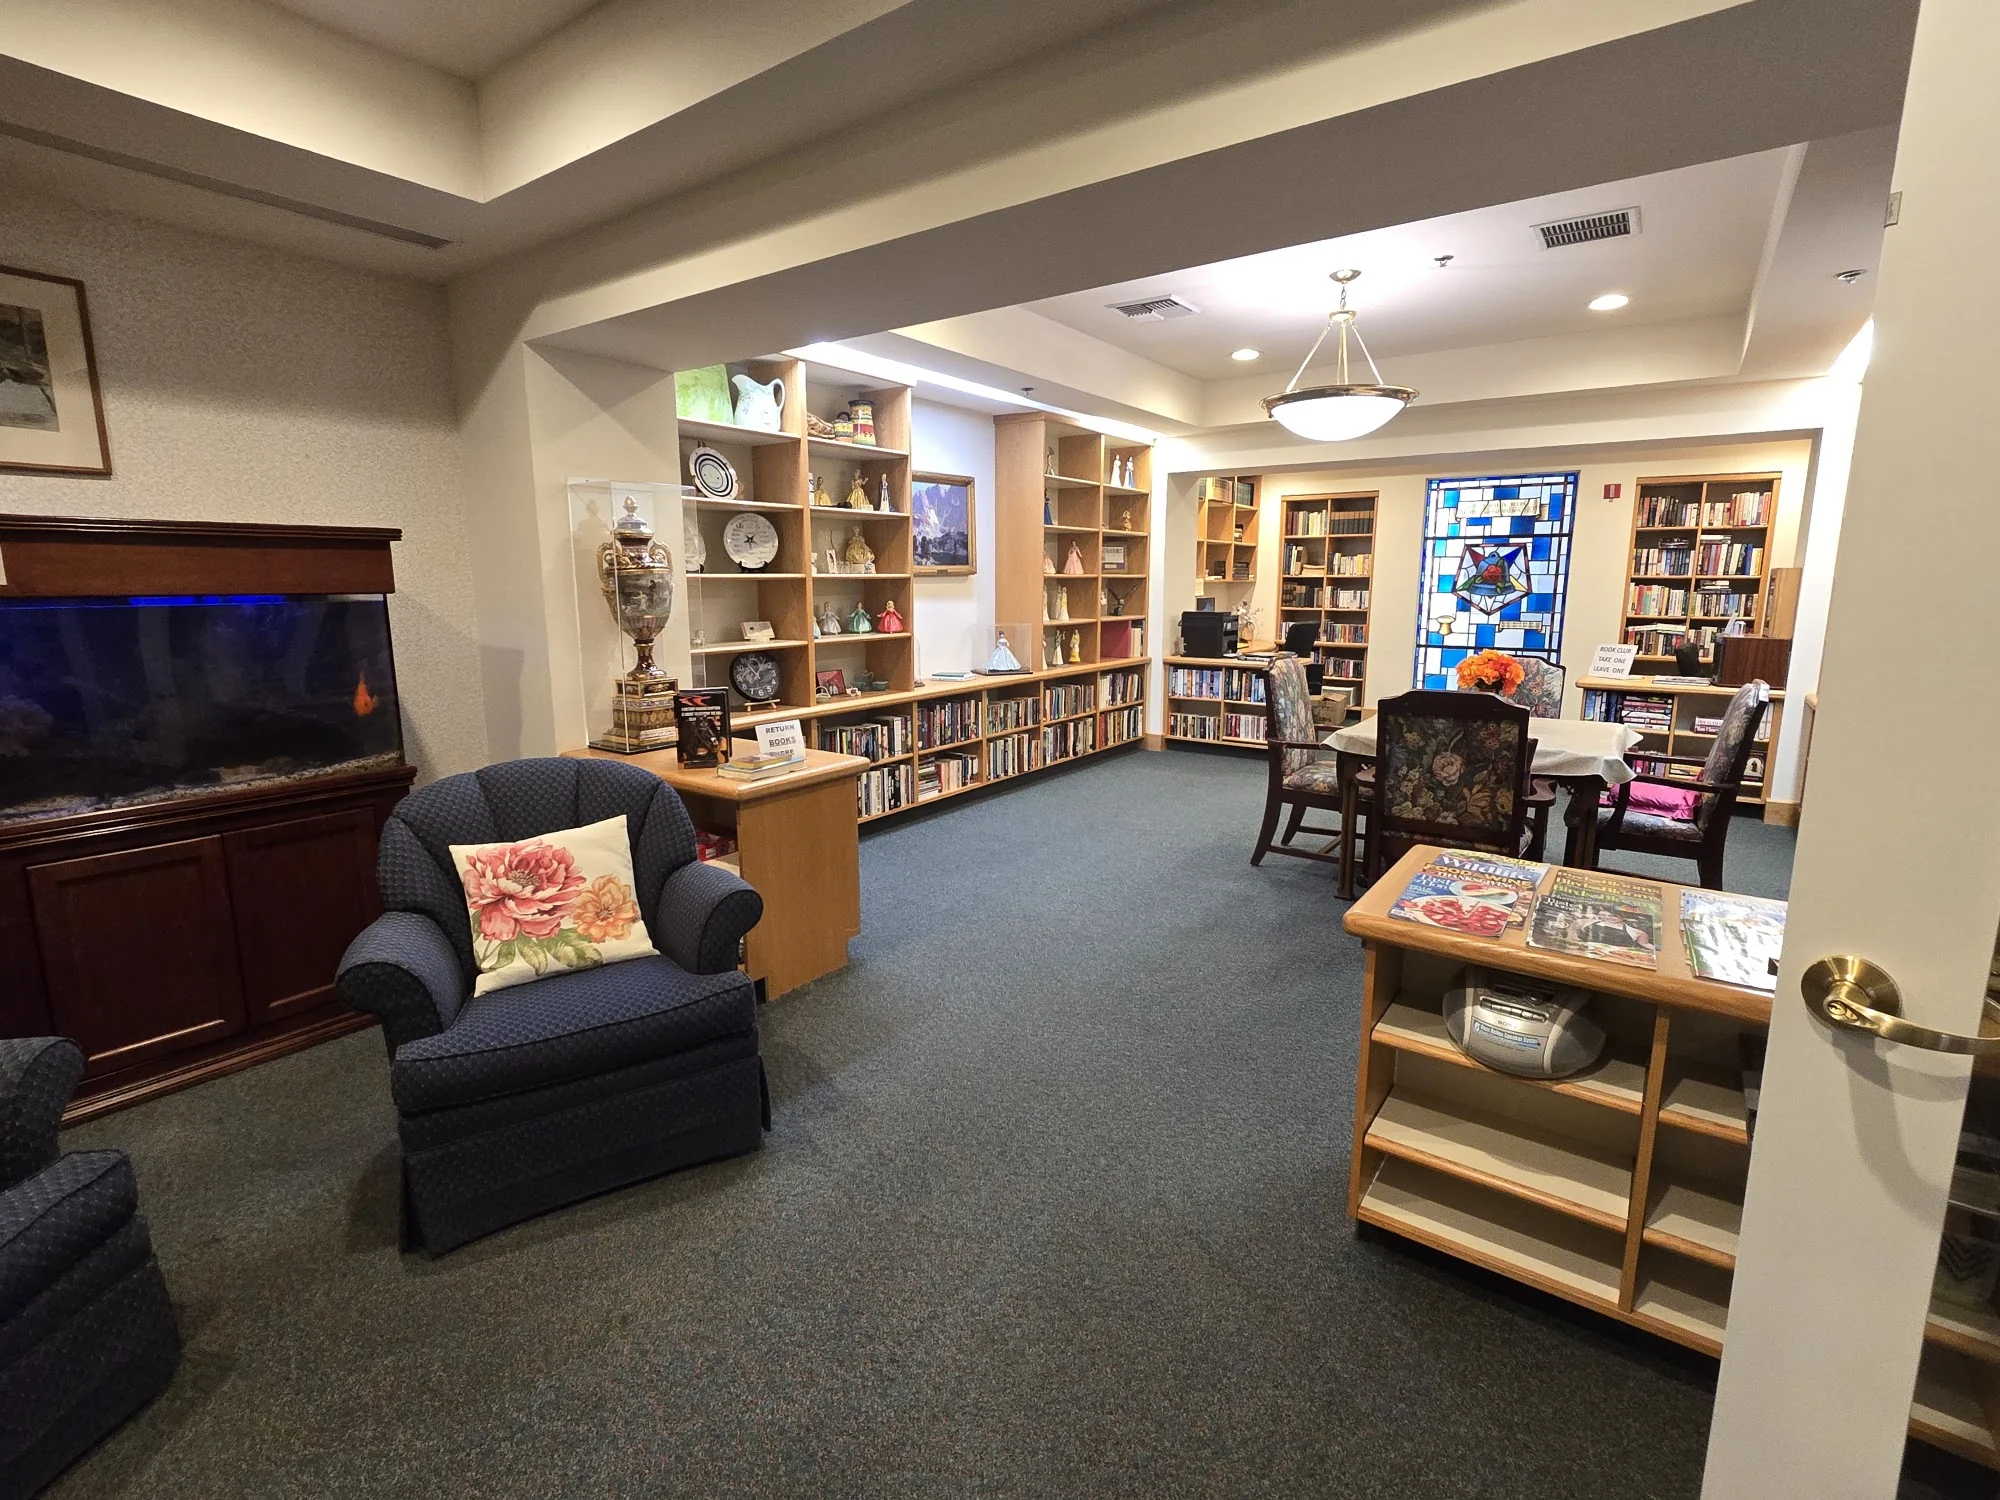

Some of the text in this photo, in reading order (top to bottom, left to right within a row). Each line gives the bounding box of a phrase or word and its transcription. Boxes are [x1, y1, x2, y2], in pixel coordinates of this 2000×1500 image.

[765, 724, 795, 734] RETURN
[768, 736, 796, 746] BOOKS
[1423, 864, 1470, 877] FOOD
[1484, 874, 1535, 890] WINE
[1440, 855, 1534, 881] Wildlife
[1437, 871, 1517, 890] THANKSGIVING
